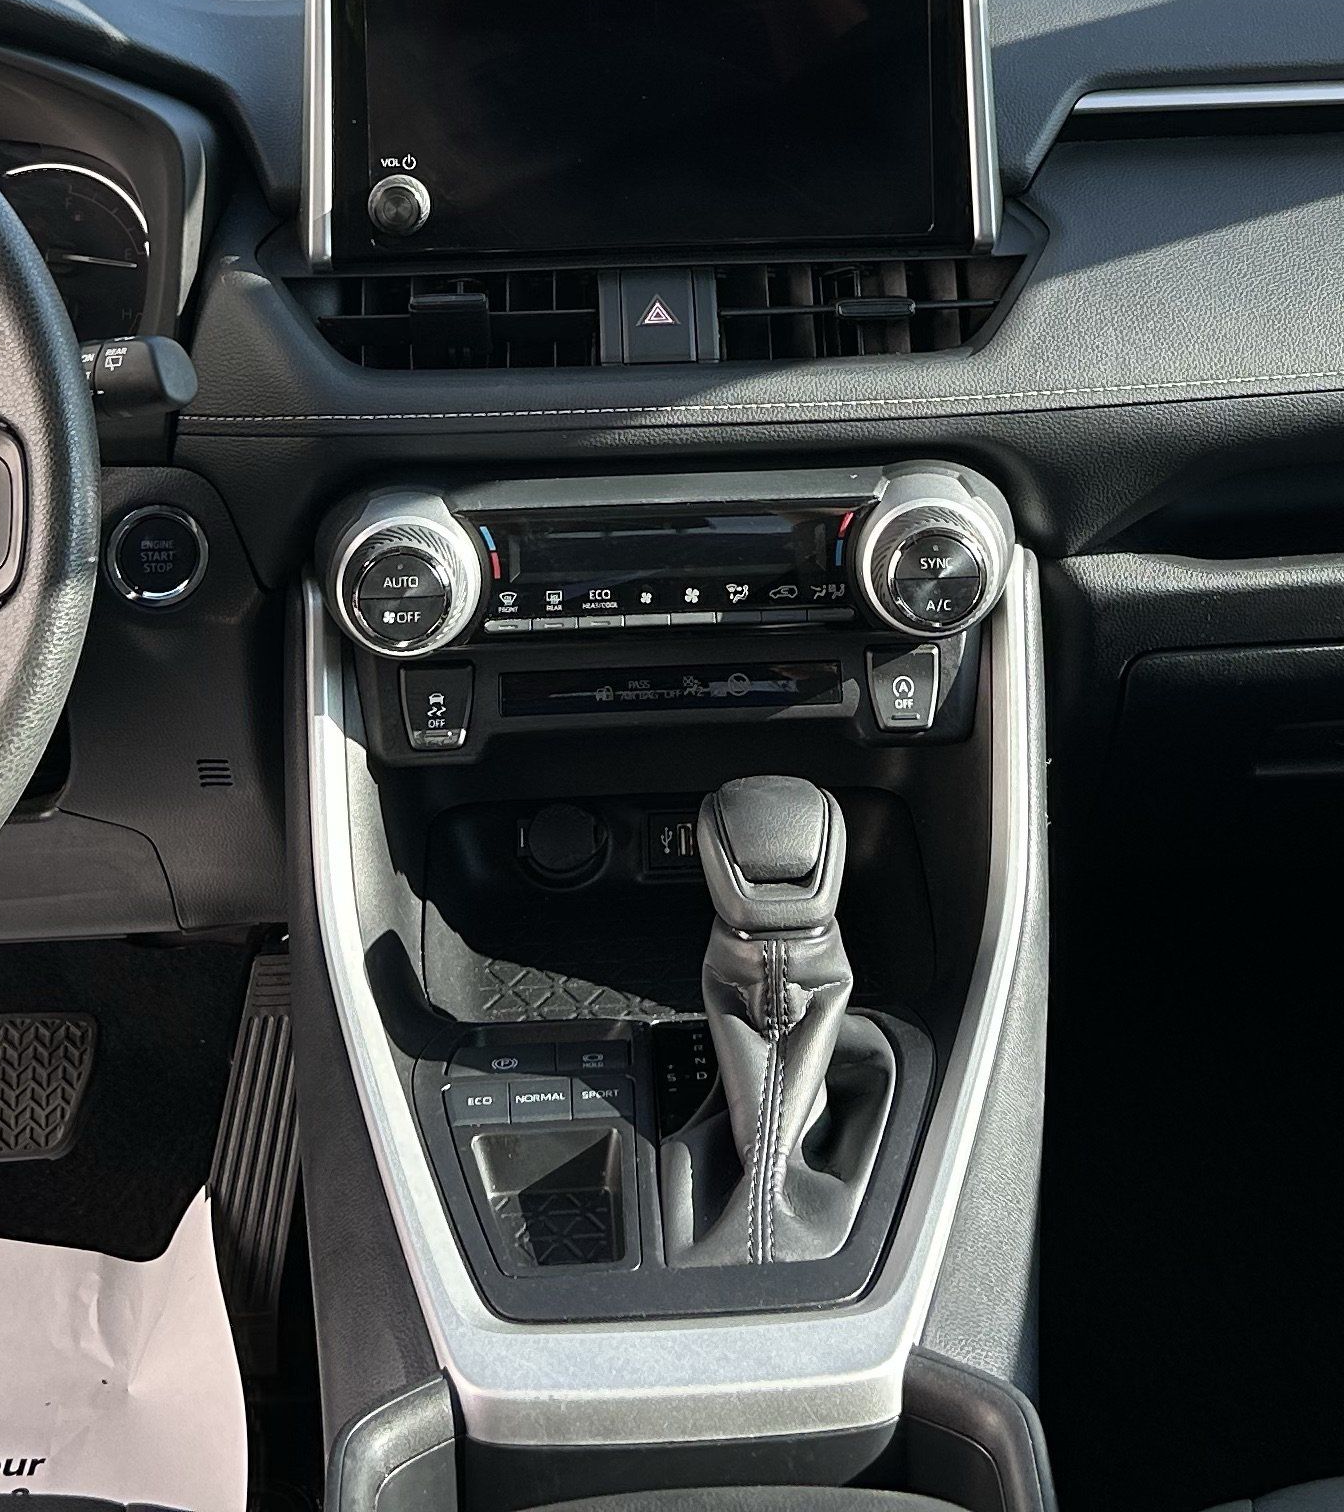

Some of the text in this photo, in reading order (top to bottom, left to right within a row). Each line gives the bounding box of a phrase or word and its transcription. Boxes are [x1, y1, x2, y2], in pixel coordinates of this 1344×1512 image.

[380, 158, 401, 168] VOL
[141, 539, 174, 550] ENGINE
[140, 551, 175, 561] START
[144, 562, 174, 573] STOP
[920, 557, 953, 570] SYNC
[383, 576, 419, 588] AUTO
[589, 589, 611, 600] ECO
[925, 599, 952, 612] A/C
[396, 612, 421, 623] OFF
[628, 679, 651, 690] PASS
[894, 698, 914, 710] OFF
[428, 718, 446, 728] OFF
[467, 1088, 620, 1106] ECO NORMAL SPORT
